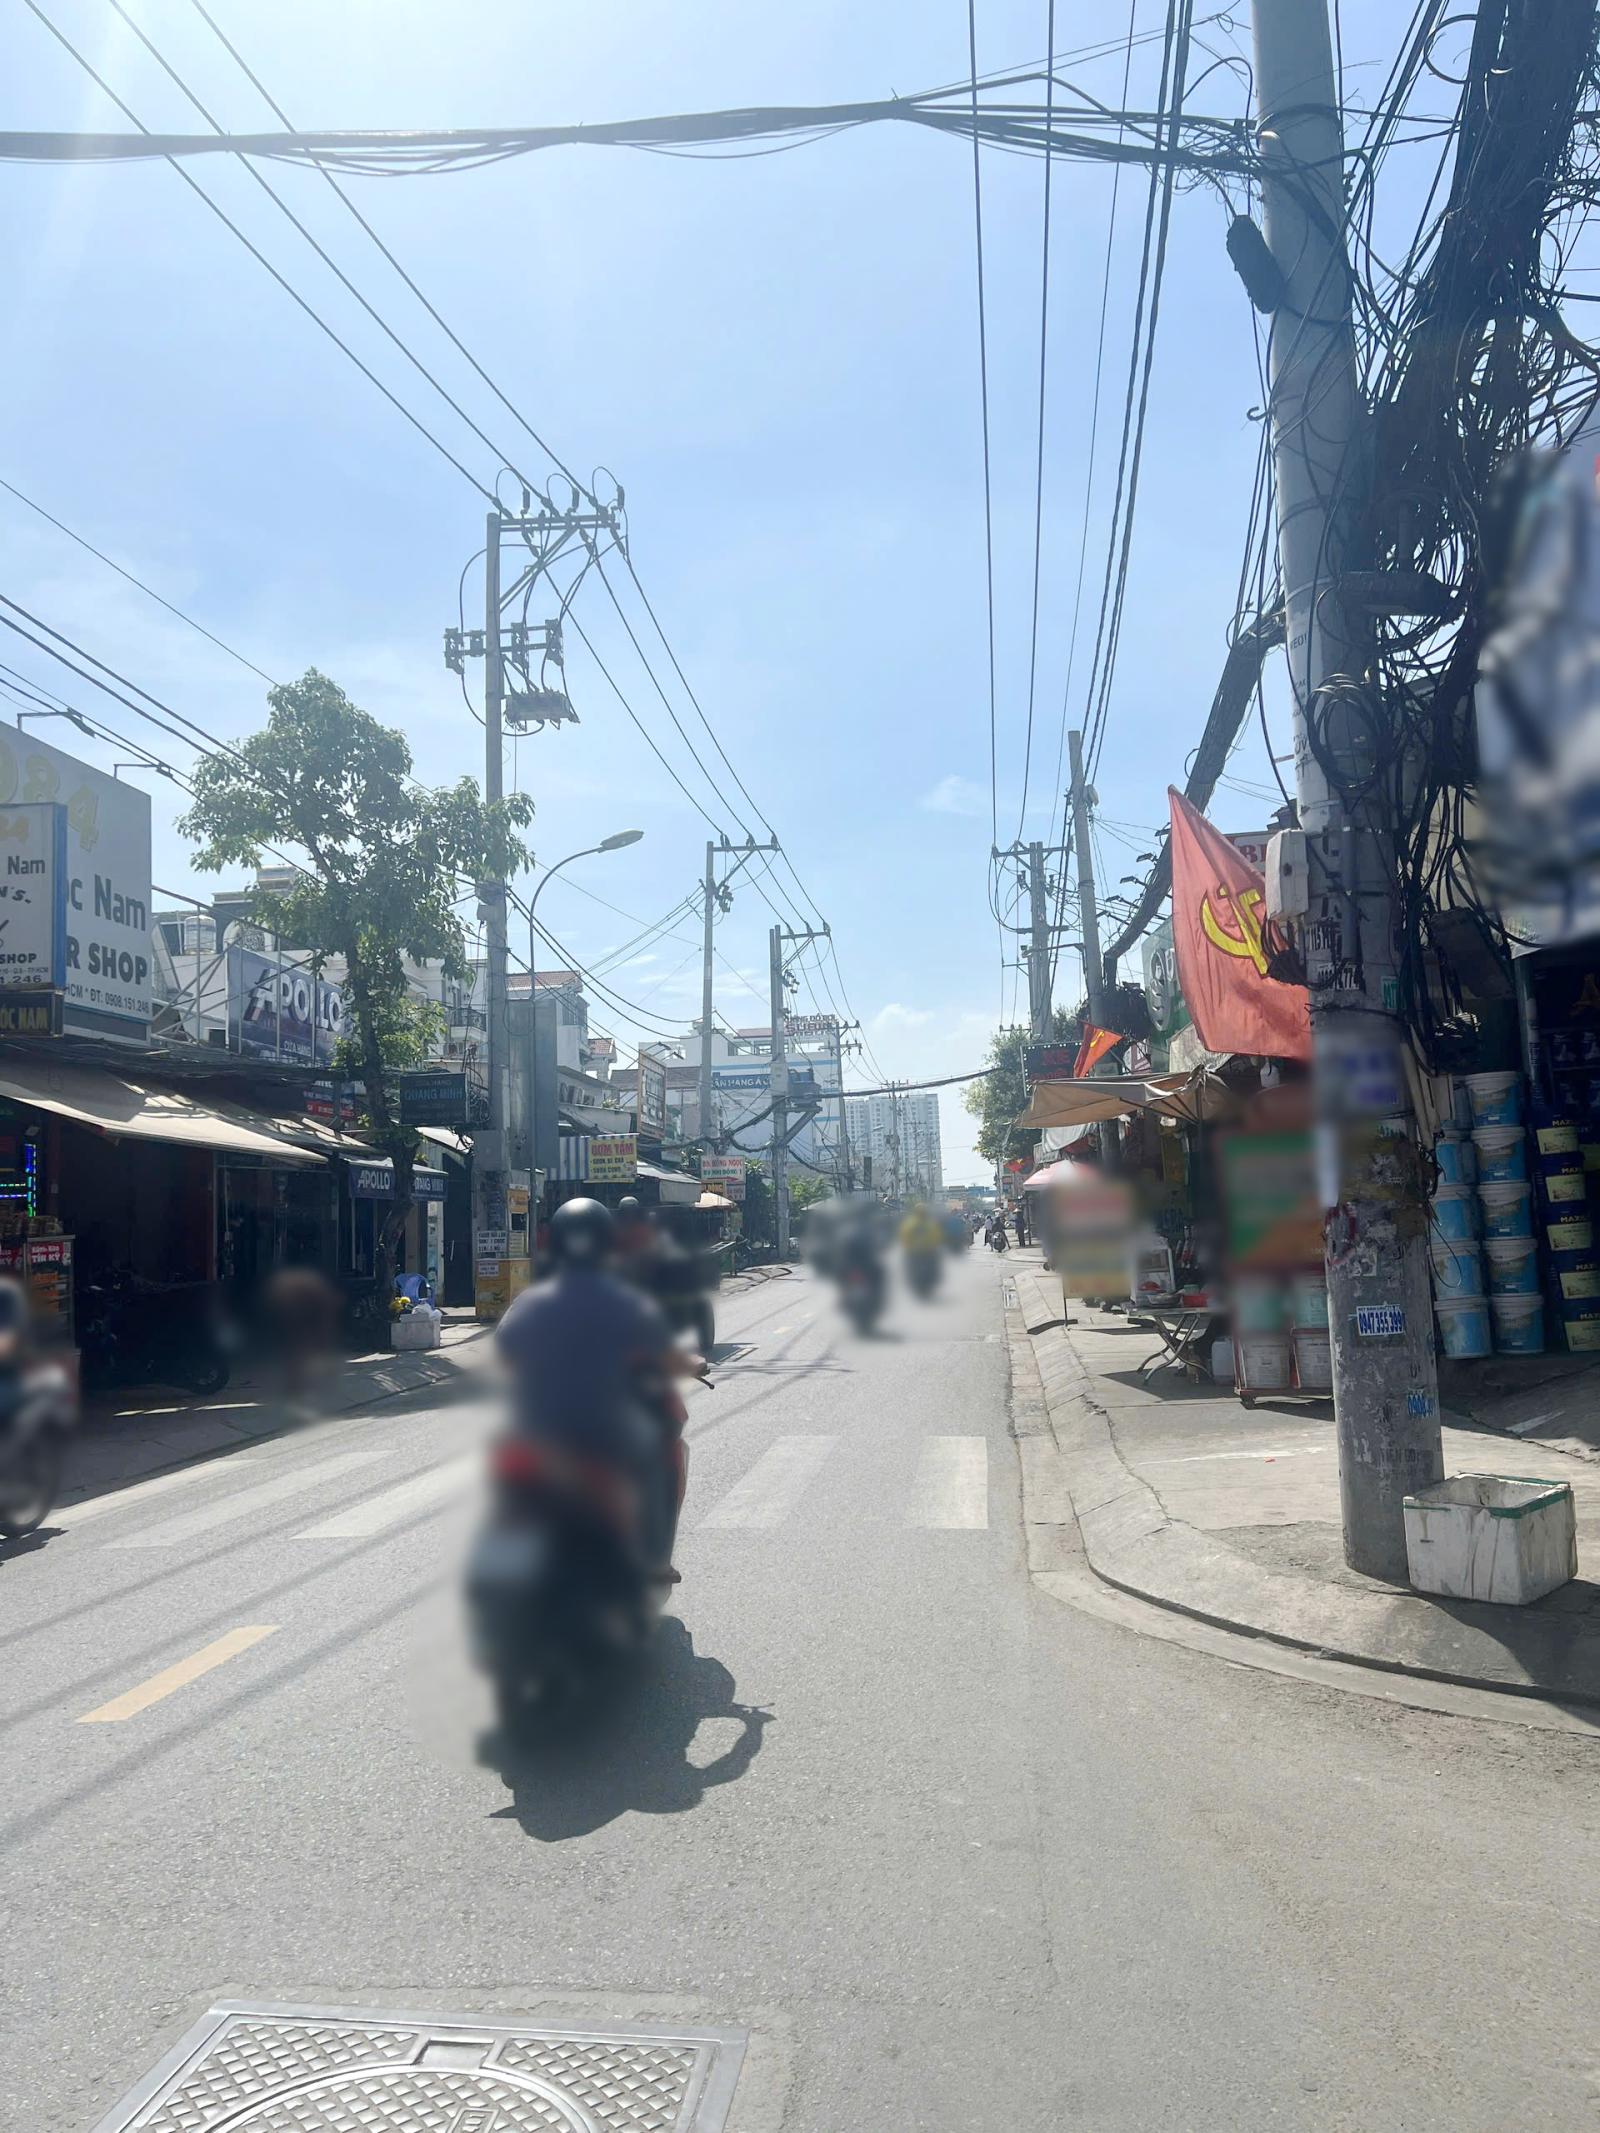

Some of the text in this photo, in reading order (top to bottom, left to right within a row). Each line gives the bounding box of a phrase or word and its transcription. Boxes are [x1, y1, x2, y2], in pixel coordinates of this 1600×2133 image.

[7, 855, 46, 875] Nam
[94, 873, 146, 931] Nam
[88, 942, 148, 985] SHOP
[357, 1170, 391, 1190] APOLLO
